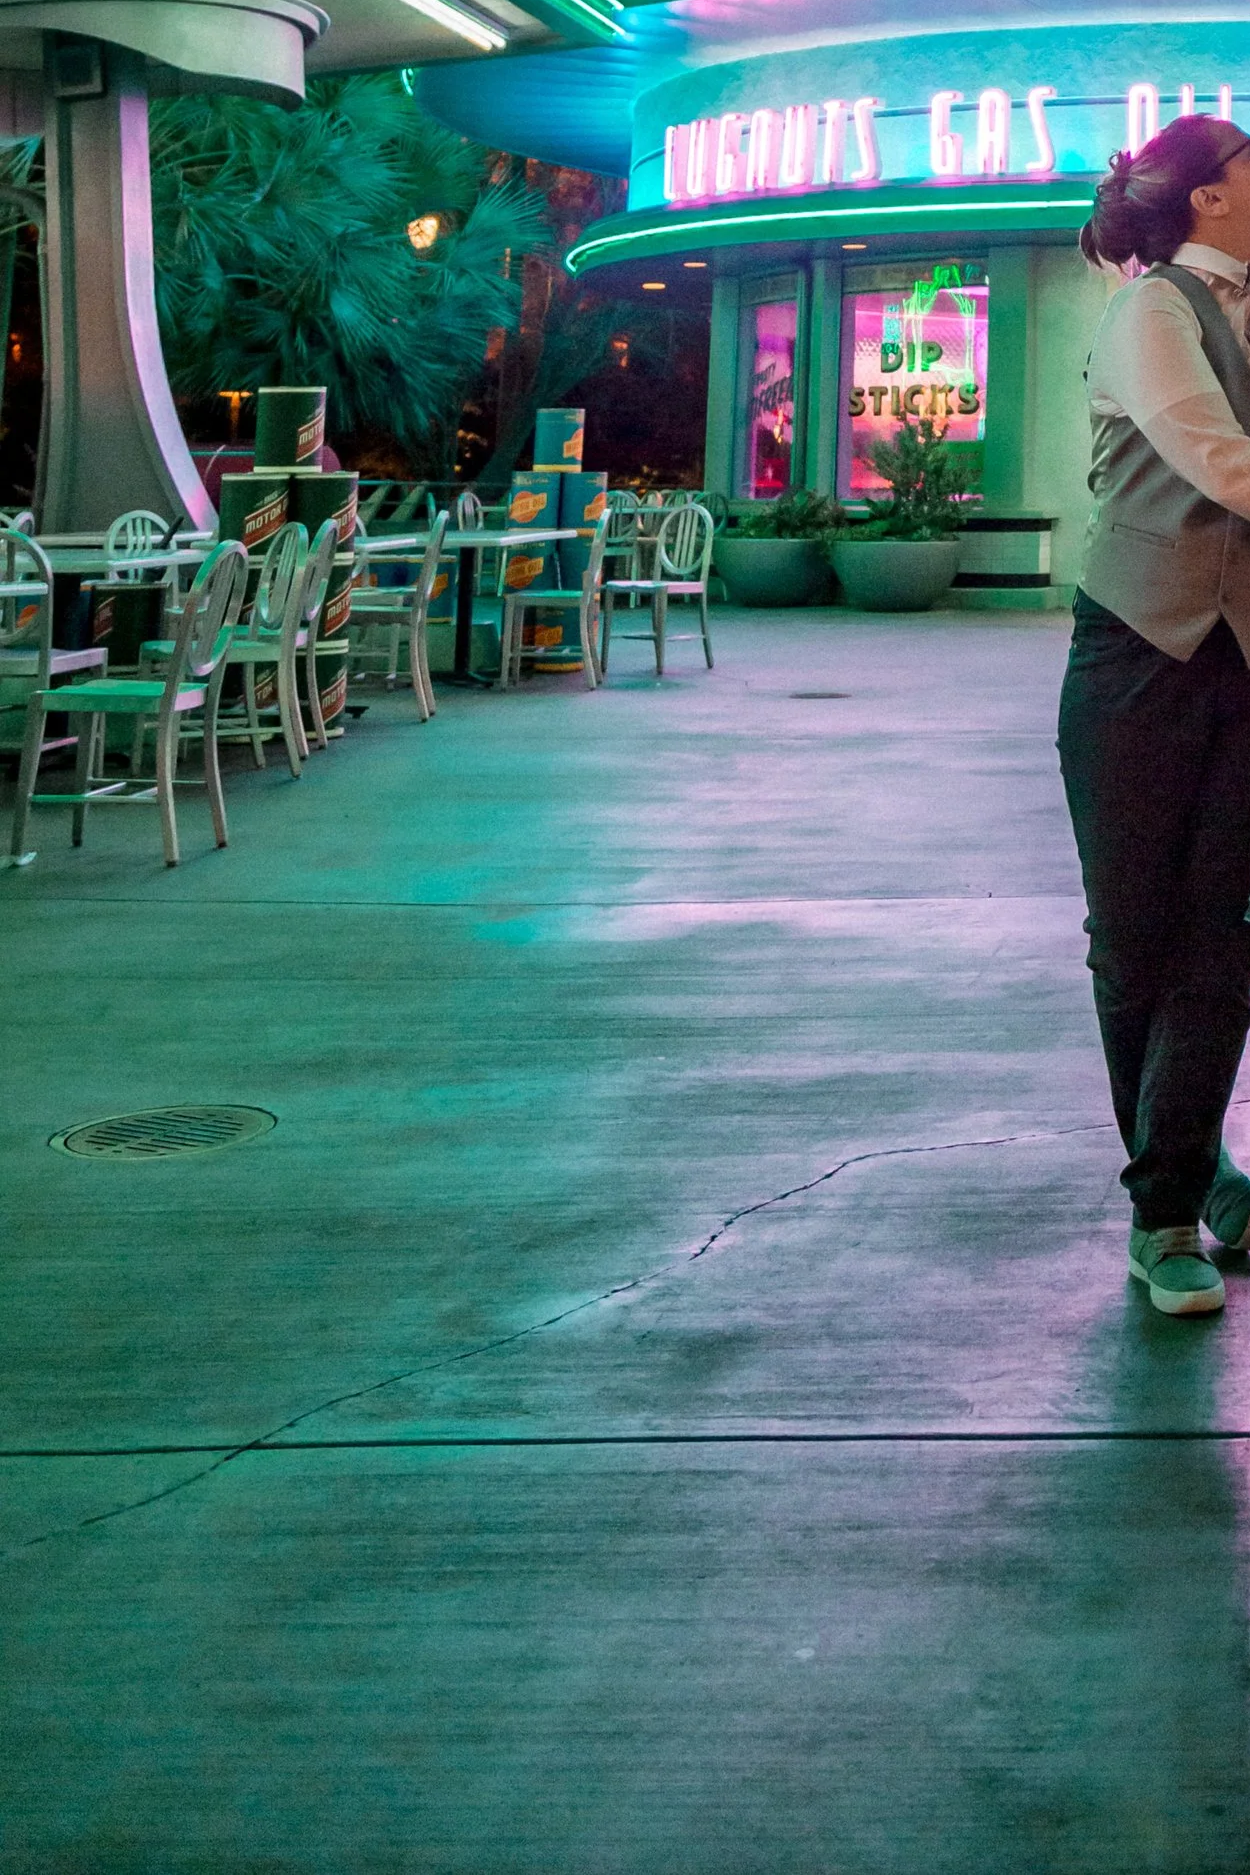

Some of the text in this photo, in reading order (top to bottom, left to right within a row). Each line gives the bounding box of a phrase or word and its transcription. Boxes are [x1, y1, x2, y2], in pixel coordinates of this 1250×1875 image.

[664, 97, 882, 202] LUGNUTS
[929, 86, 1058, 176] GAS
[880, 341, 943, 373] DIP
[848, 382, 980, 417] STICKS
[245, 505, 281, 534] MOTOR
